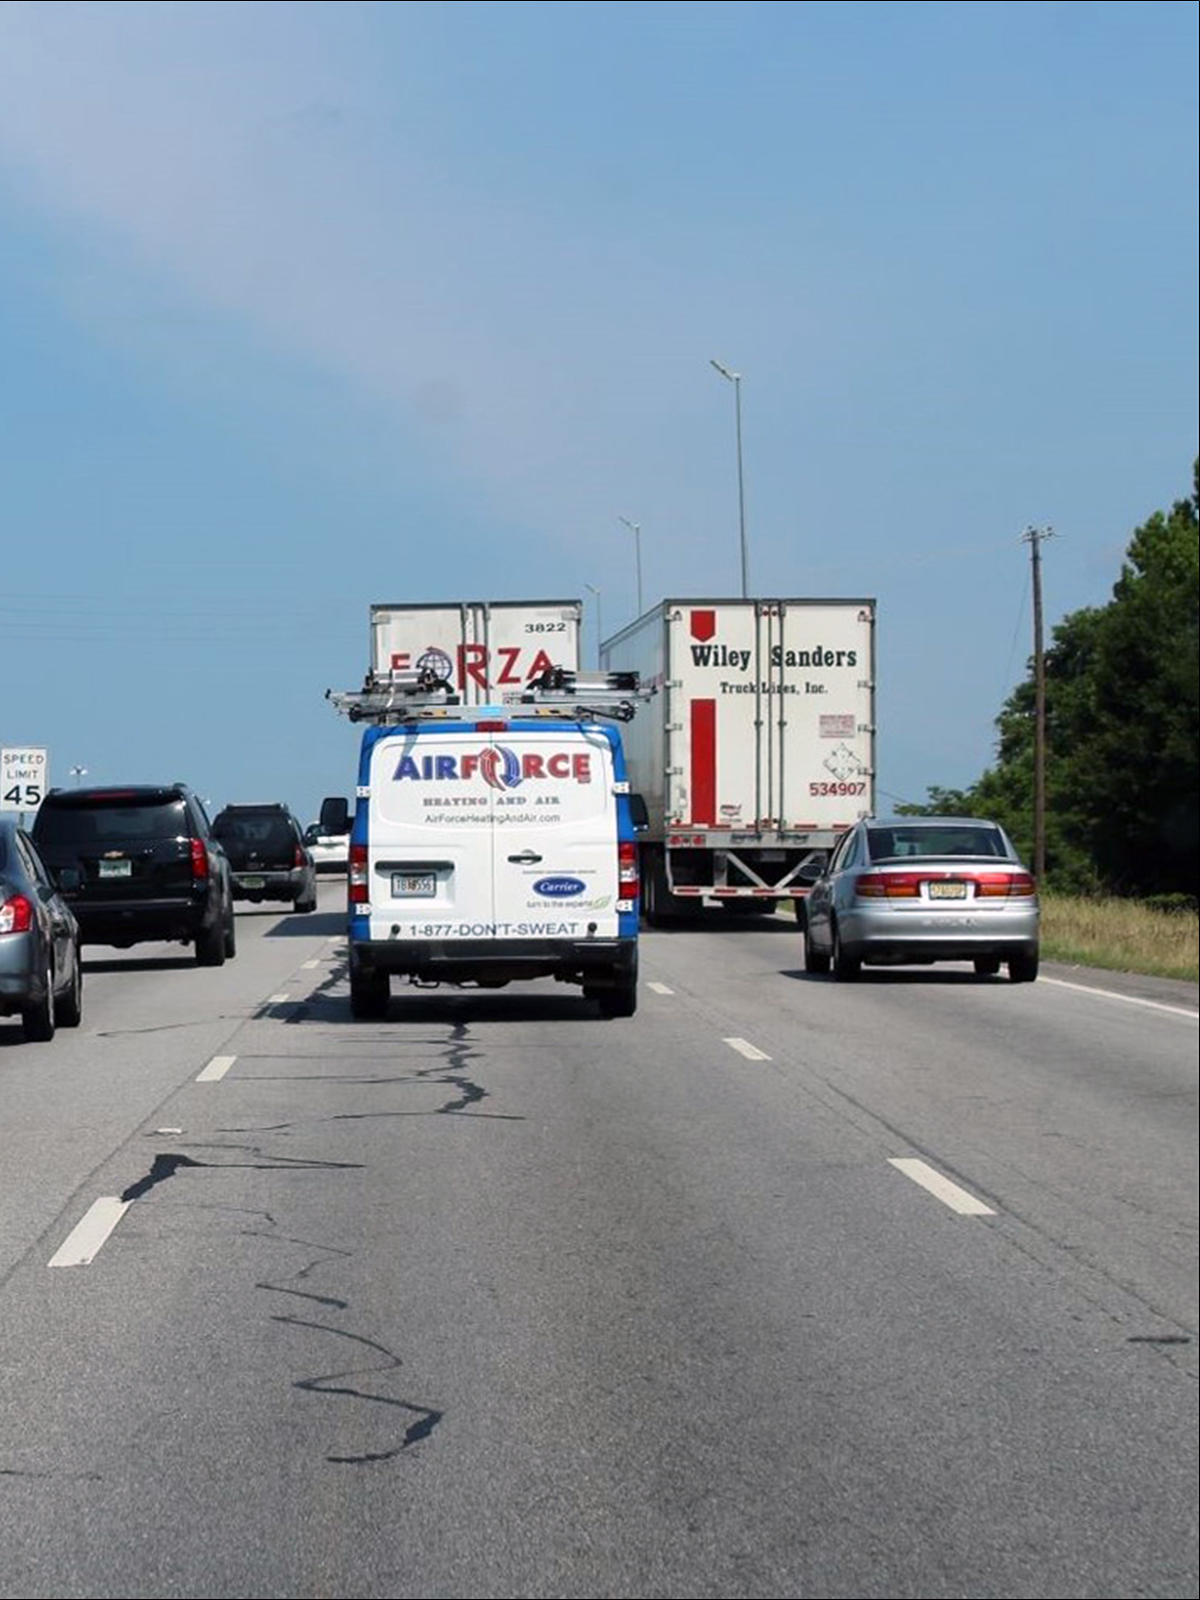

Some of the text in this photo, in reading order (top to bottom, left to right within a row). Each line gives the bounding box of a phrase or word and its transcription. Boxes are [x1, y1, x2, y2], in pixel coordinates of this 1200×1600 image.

[524, 623, 566, 633] 3822
[690, 645, 857, 671] Wiley Sanders
[720, 682, 756, 694] Truck
[805, 682, 828, 694] Inc.
[3, 753, 44, 764] SPEED
[392, 745, 591, 791] AIRFORCE
[6, 770, 39, 779] LIMIT
[3, 785, 41, 805] 45
[810, 783, 865, 796] 534907
[422, 796, 560, 806] HEATING AND AIR
[539, 881, 579, 892] Carrier
[410, 923, 578, 936] 1-877-DON'T-SWEAT
